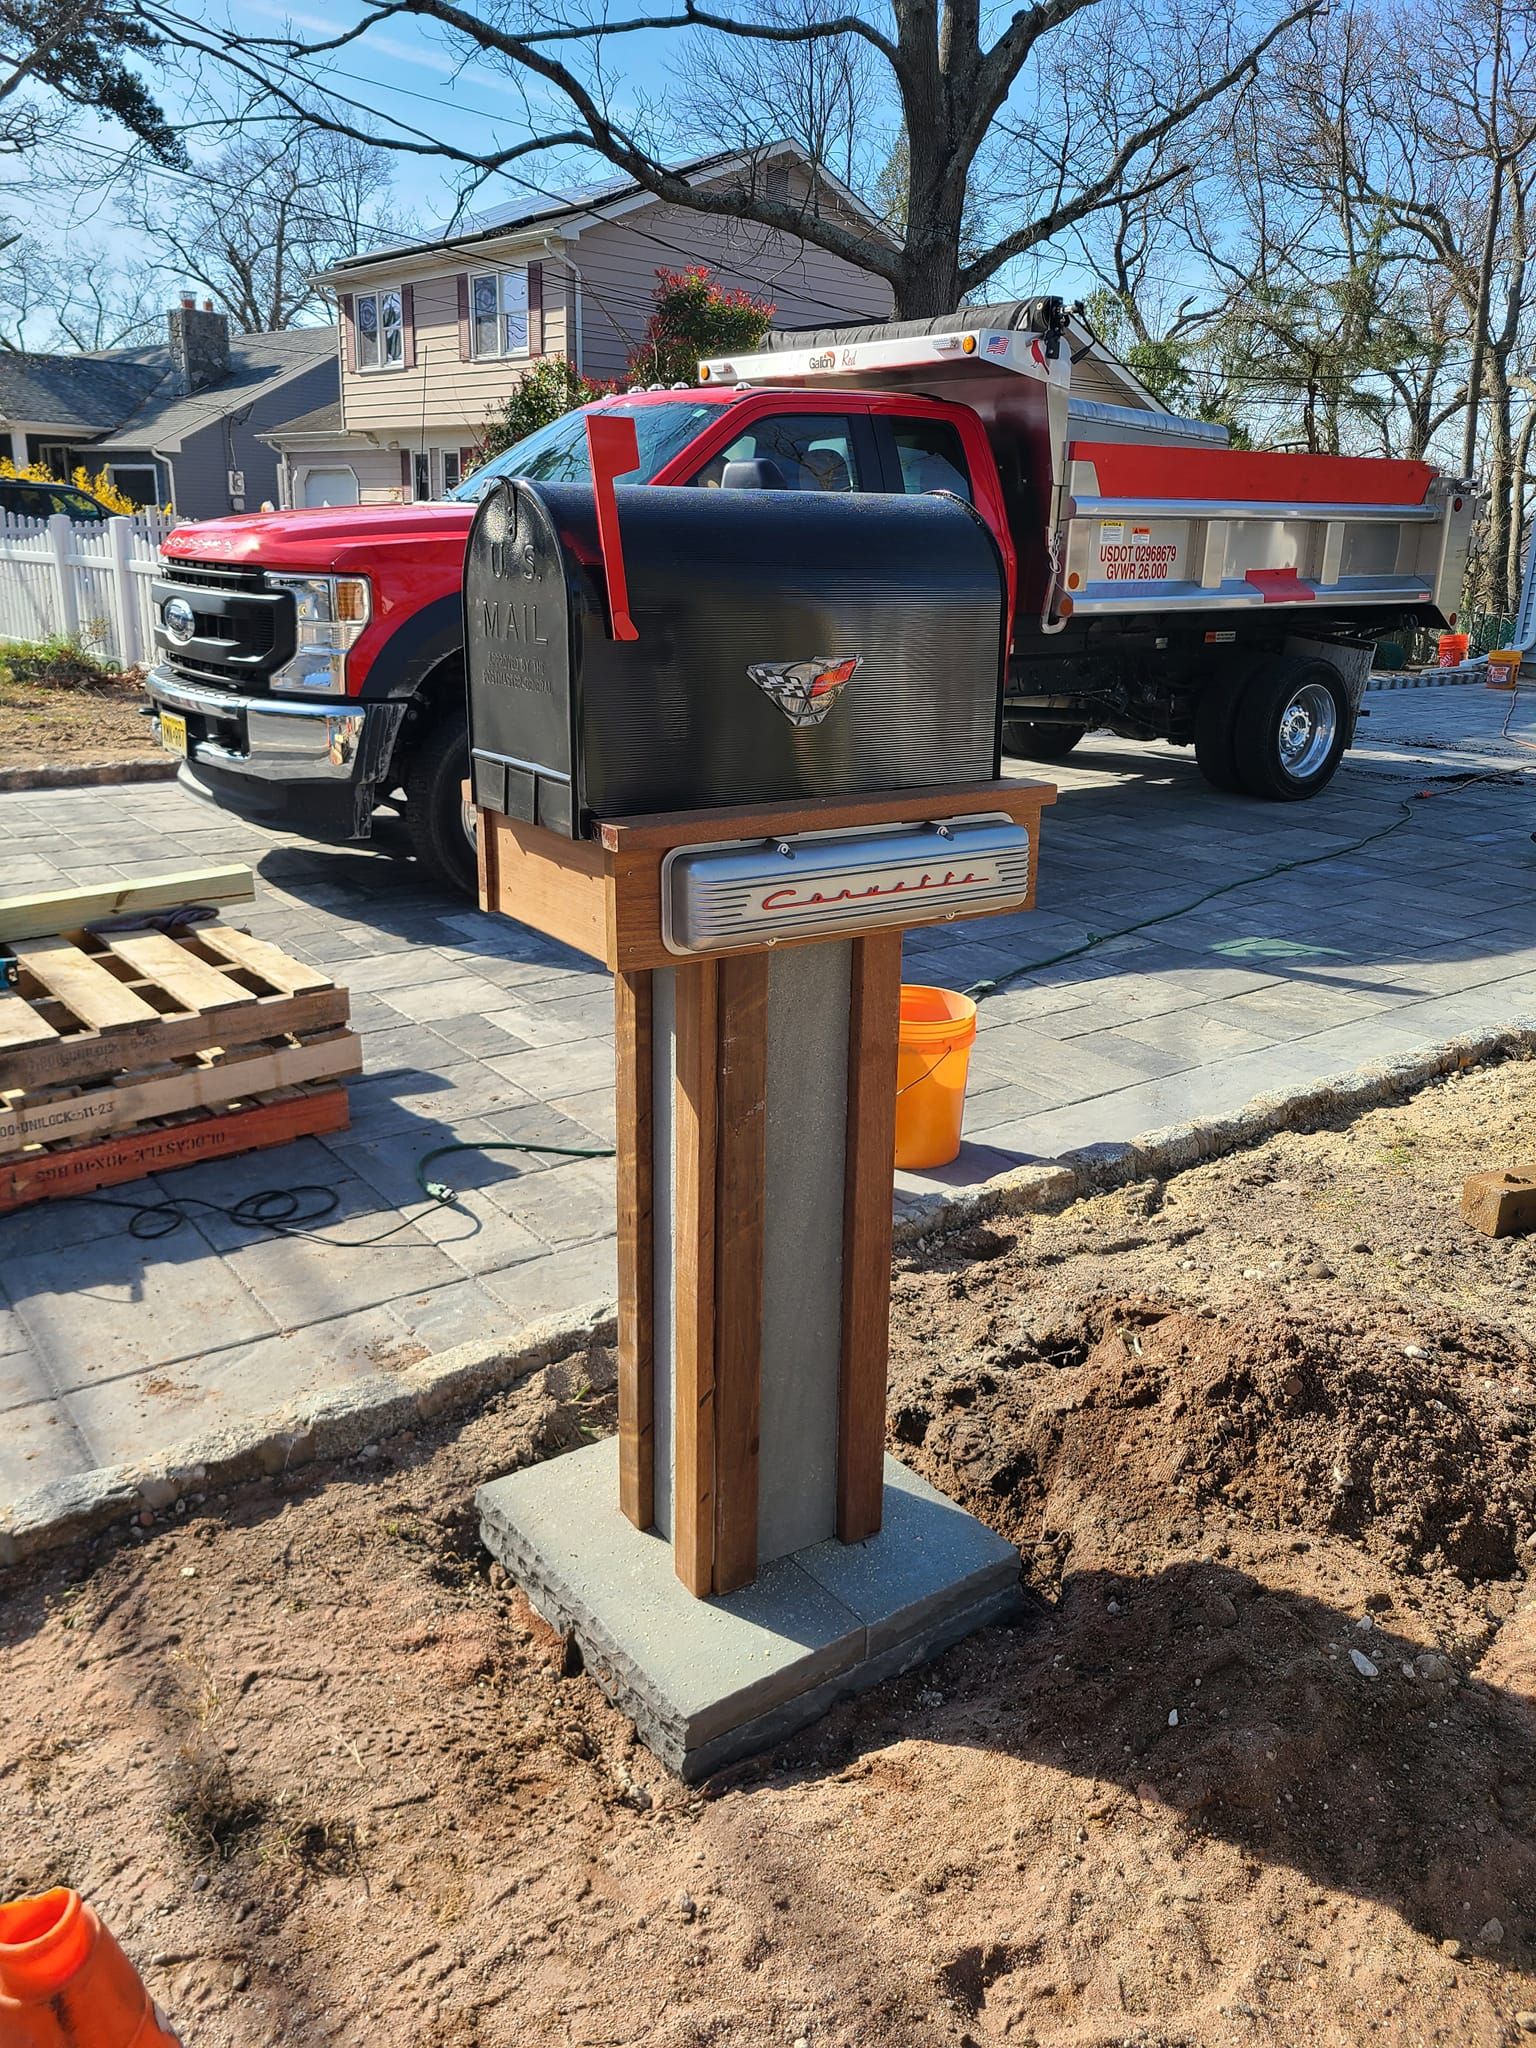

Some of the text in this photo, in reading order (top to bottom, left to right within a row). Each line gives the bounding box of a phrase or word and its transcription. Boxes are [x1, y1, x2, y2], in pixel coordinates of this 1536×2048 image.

[809, 353, 835, 369] Galion
[1100, 546, 1177, 562] USDOT 02968679
[1106, 563, 1168, 580] GVWR 26,000
[482, 600, 549, 645] MAIL
[761, 871, 990, 911] Corvette
[135, 1131, 226, 1164] OLDCASTLE
